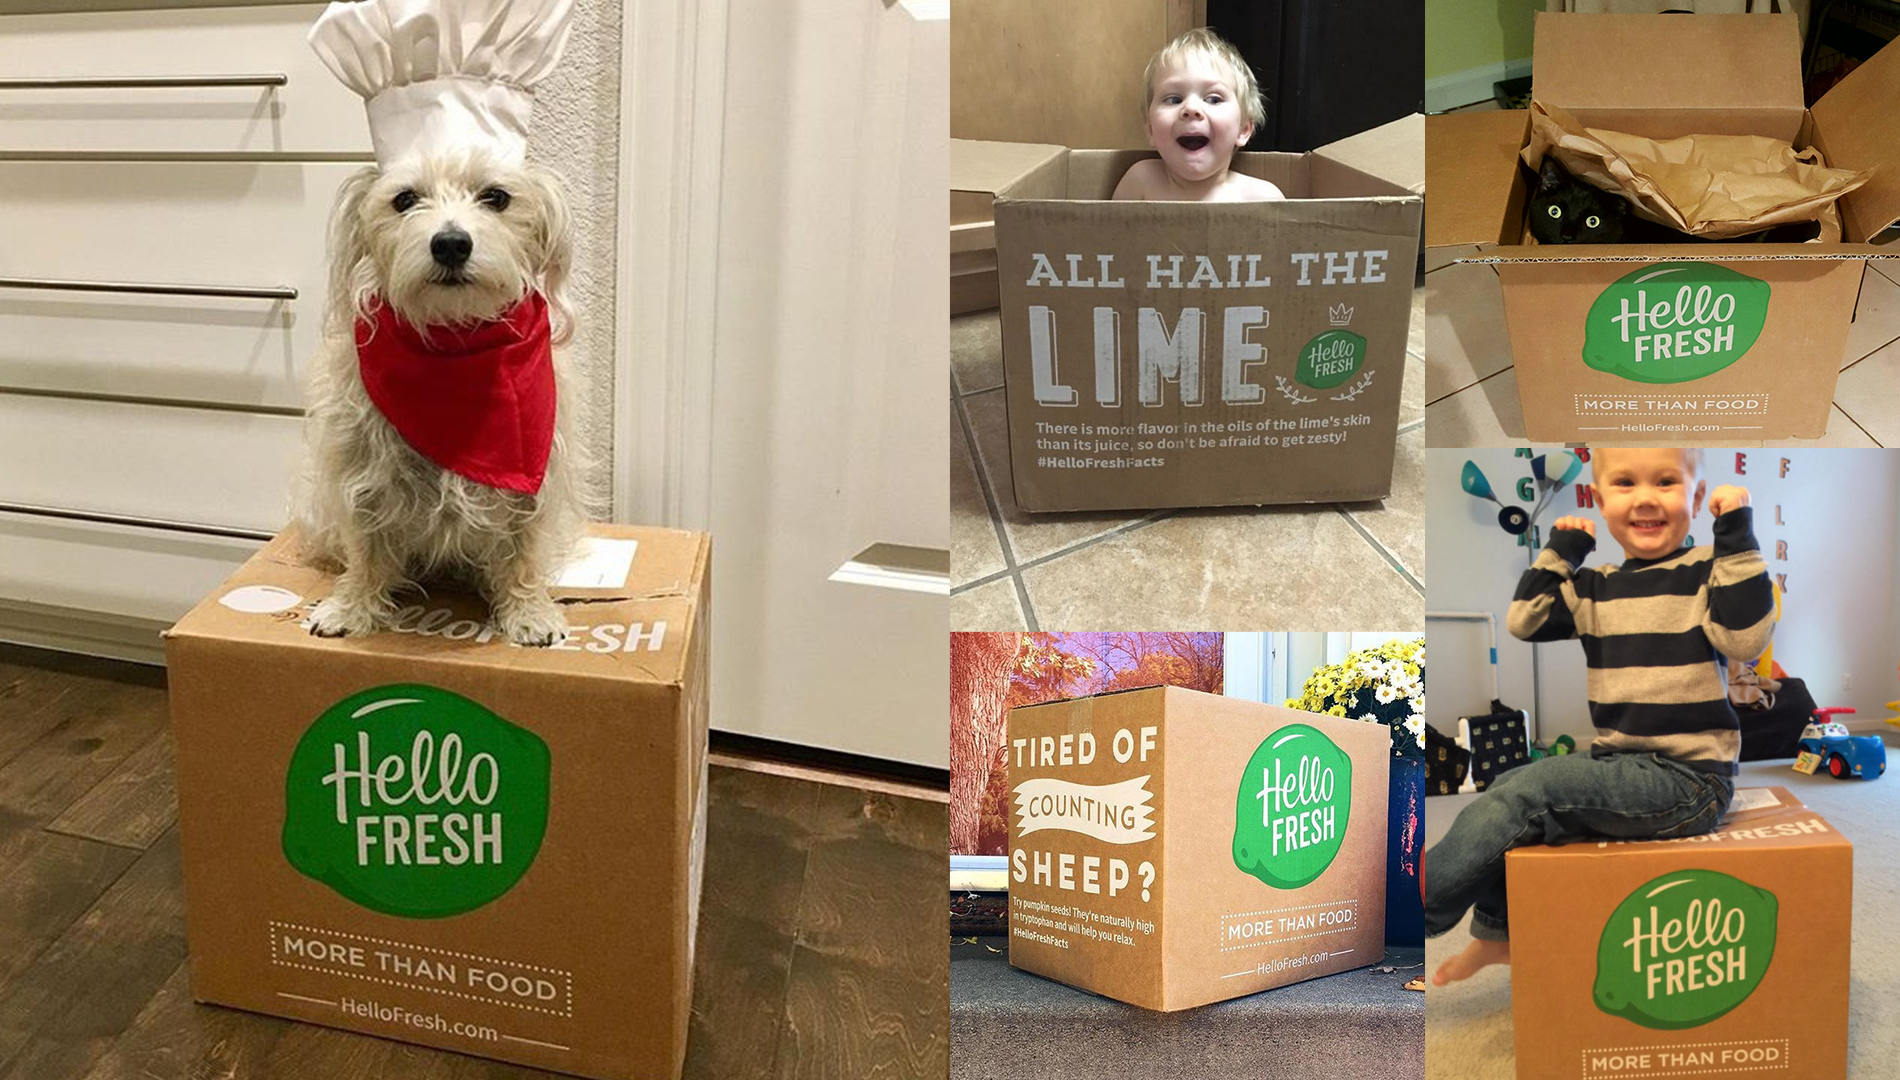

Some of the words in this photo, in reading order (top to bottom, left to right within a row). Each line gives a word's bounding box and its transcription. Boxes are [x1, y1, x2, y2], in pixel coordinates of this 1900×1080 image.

[1026, 253, 1125, 288] ALL
[1146, 254, 1271, 289] HAIL
[1291, 250, 1388, 286] THE
[1611, 285, 1736, 342] Hello
[1028, 305, 1270, 408] LIME
[1308, 340, 1354, 368] Hello
[1635, 324, 1734, 362] FRESH
[1315, 357, 1353, 378] FRESH
[1584, 401, 1639, 410] MORE
[1645, 400, 1698, 410] THAN
[1704, 400, 1759, 410] FOOD
[1035, 422, 1078, 435] There
[1081, 423, 1093, 435] is
[1096, 425, 1135, 436] more
[1138, 422, 1179, 435] flavor
[1183, 422, 1197, 434] in
[1200, 422, 1225, 433] the
[1227, 420, 1253, 432] oils
[1255, 419, 1272, 431] of
[1273, 418, 1297, 430] the
[1299, 416, 1340, 429] lime's
[1342, 413, 1371, 427] skin
[1036, 438, 1070, 450] than
[1073, 438, 1091, 451] its
[1094, 439, 1134, 453] juice,
[1137, 441, 1153, 450] so
[1157, 438, 1195, 450] don't
[1199, 437, 1216, 448] be
[1219, 435, 1261, 447] afraid
[1263, 434, 1279, 446] to
[1282, 434, 1305, 448] get
[1307, 430, 1348, 445] zesty!
[1621, 423, 1720, 432] HelloFresh.com
[1037, 456, 1165, 469] #HelloFreshFacts
[1735, 452, 1747, 476] E
[1779, 457, 1791, 479] F
[1516, 477, 1534, 502] G
[1575, 484, 1594, 509] H
[1775, 505, 1785, 526] L
[1776, 540, 1788, 561] R
[1013, 732, 1097, 768] TIRED
[1112, 726, 1157, 764] OF
[322, 730, 499, 824] Hello
[1256, 755, 1334, 827] Hello
[1029, 794, 1136, 830] COUNTING
[356, 813, 502, 865] FRESH
[1272, 805, 1335, 857] FRESH
[1012, 848, 1156, 903] SHEEP?
[1013, 896, 1023, 909] Try
[1023, 899, 1050, 912] pumpkin
[1051, 904, 1072, 917] seeds!
[1073, 907, 1099, 922] They're
[1100, 914, 1135, 931] naturally
[1136, 919, 1155, 936] high
[1013, 911, 1020, 920] in
[1020, 913, 1054, 928] tryptophan
[1054, 920, 1067, 931] and
[1068, 923, 1081, 934] will
[1081, 926, 1097, 939] help
[1099, 931, 1112, 942] you
[1113, 933, 1136, 947] relax.
[1228, 920, 1273, 941] MORE
[1278, 914, 1315, 933] THAN
[1319, 909, 1352, 927] FOOD
[1013, 927, 1069, 949] #HelloFreshFacts
[1623, 898, 1745, 973] Hello
[283, 935, 365, 967] MORE
[375, 951, 456, 984] THAN
[468, 968, 557, 1000] FOOD
[1257, 951, 1329, 976] HelloFresh.com
[1647, 946, 1746, 1000] FRESH
[341, 998, 498, 1041] HelloFresh.com
[1592, 1054, 1651, 1072] MORE
[1658, 1051, 1714, 1068] THAN
[1722, 1048, 1780, 1065] FOOD
